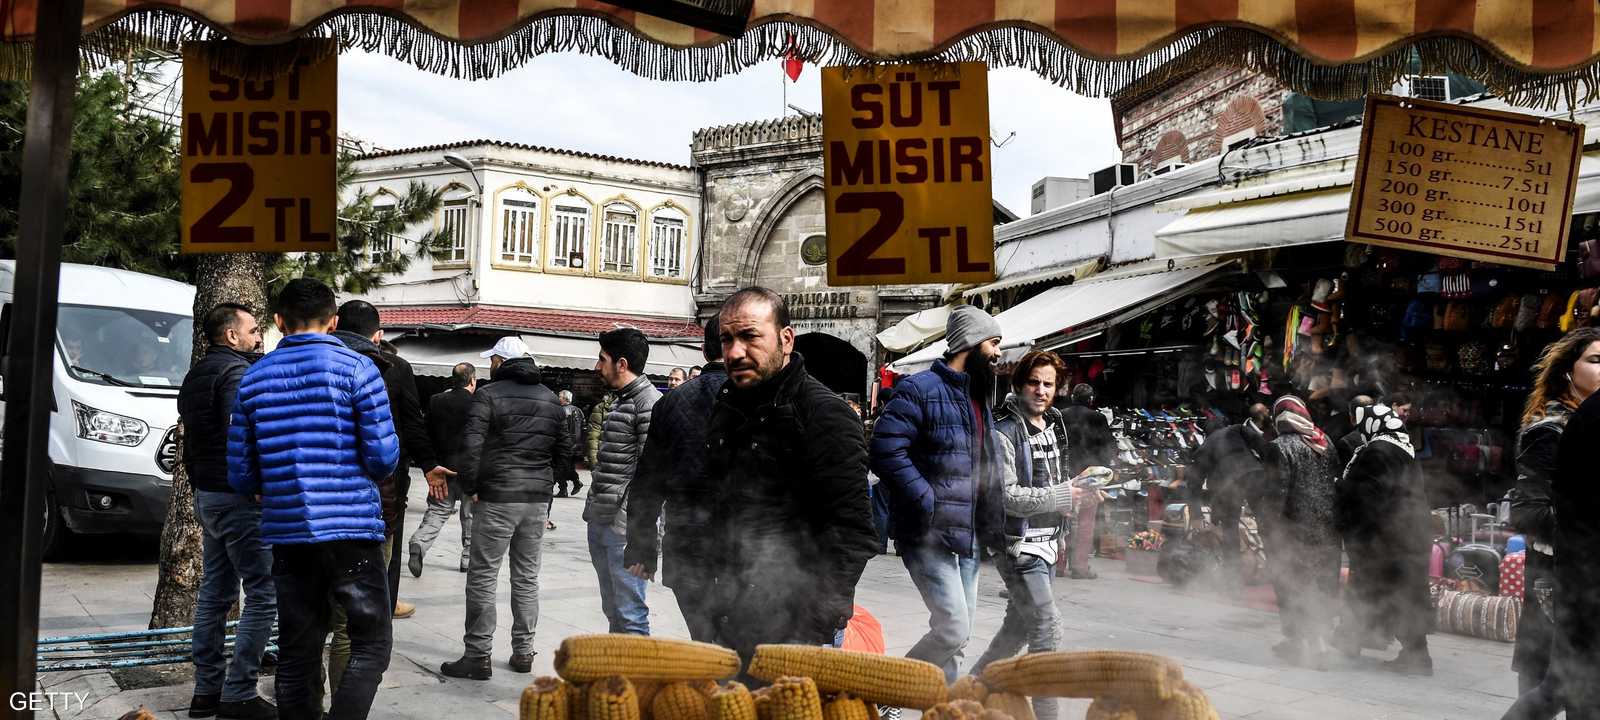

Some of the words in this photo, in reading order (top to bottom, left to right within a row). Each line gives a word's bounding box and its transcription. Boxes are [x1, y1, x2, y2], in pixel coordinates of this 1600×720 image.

[851, 72, 960, 129] SÜT
[187, 110, 331, 156] MISIR
[1406, 114, 1544, 154] KESTANE
[830, 136, 984, 186] MISIR
[1388, 141, 1425, 158] 100
[1384, 159, 1422, 177] 150
[190, 162, 255, 243] 2
[264, 198, 331, 243] TL
[1380, 179, 1418, 197] 200
[1376, 198, 1415, 216] 300
[835, 191, 906, 277] 2
[918, 226, 990, 273] TL
[1374, 217, 1412, 235] 500
[779, 292, 850, 306] APALIÇARŞI
